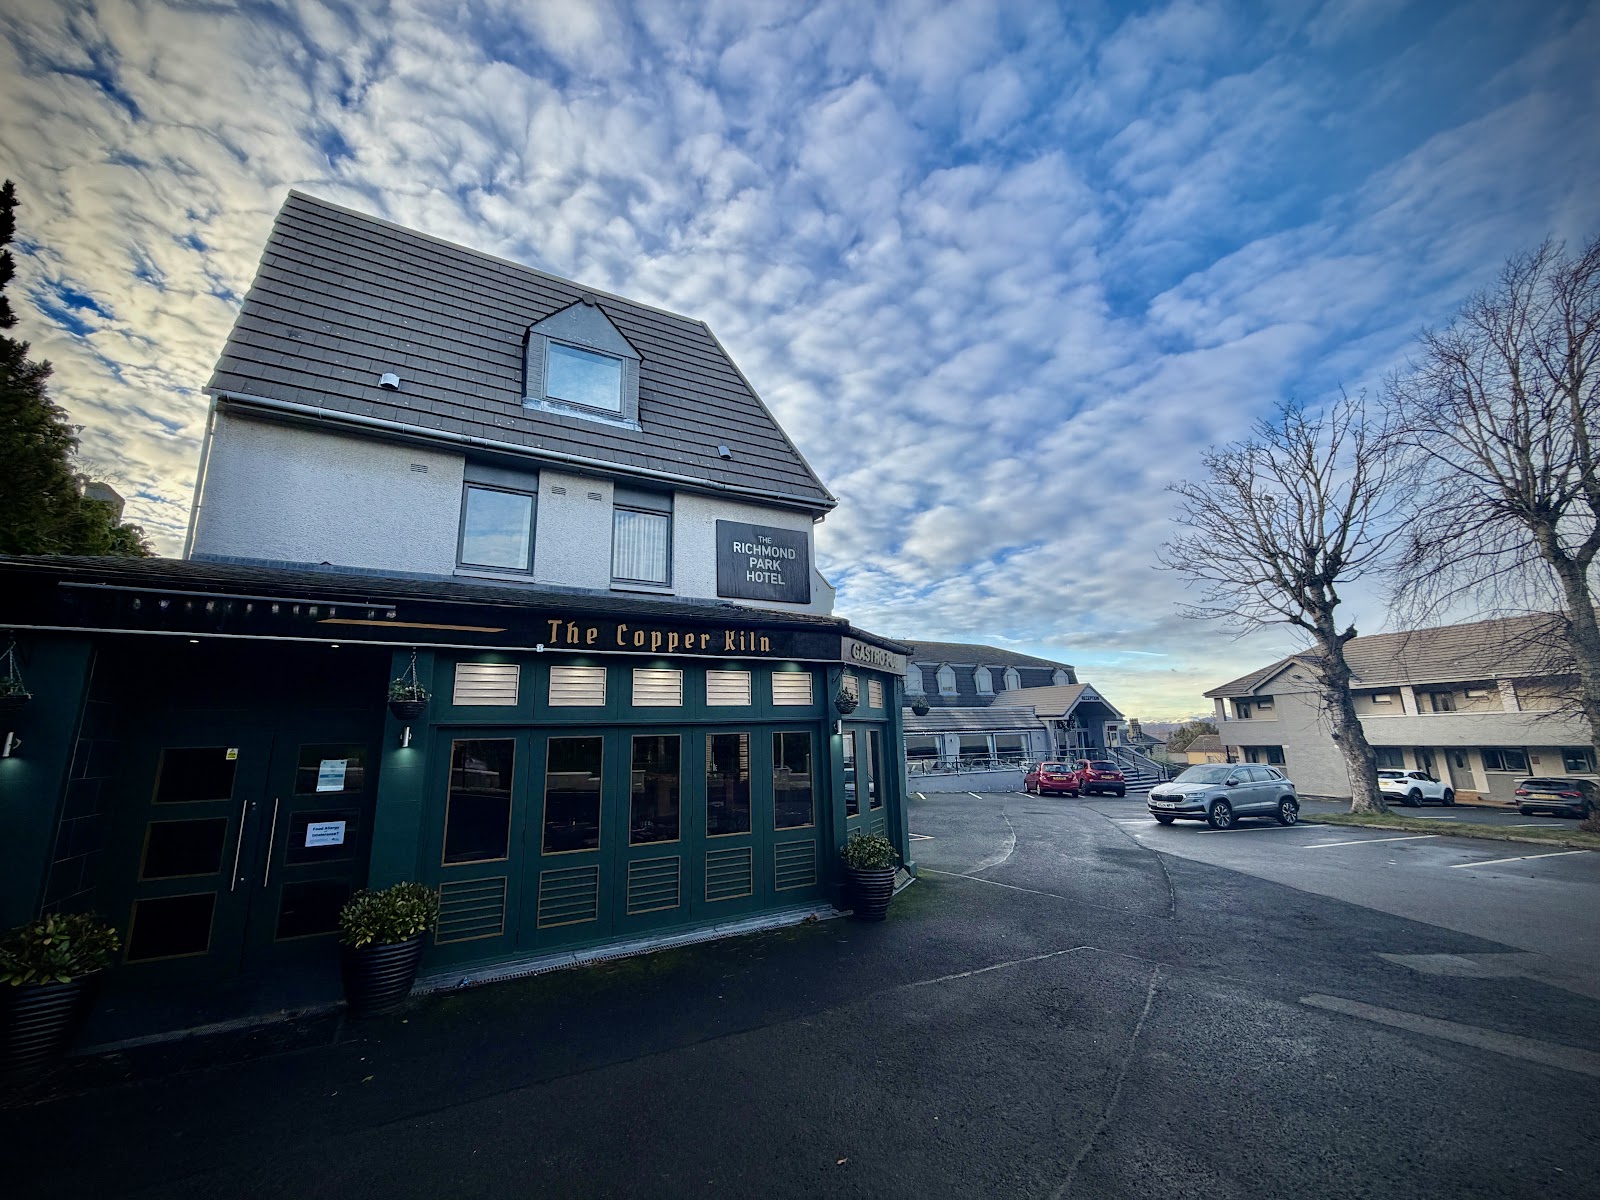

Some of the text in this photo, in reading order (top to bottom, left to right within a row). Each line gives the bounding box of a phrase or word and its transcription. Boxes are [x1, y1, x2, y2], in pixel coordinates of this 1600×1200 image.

[758, 535, 772, 544] THE
[733, 541, 796, 560] RICHMOND
[749, 557, 781, 571] PARK
[746, 570, 785, 585] HOTEL
[547, 619, 771, 652] The Copper Kiln
